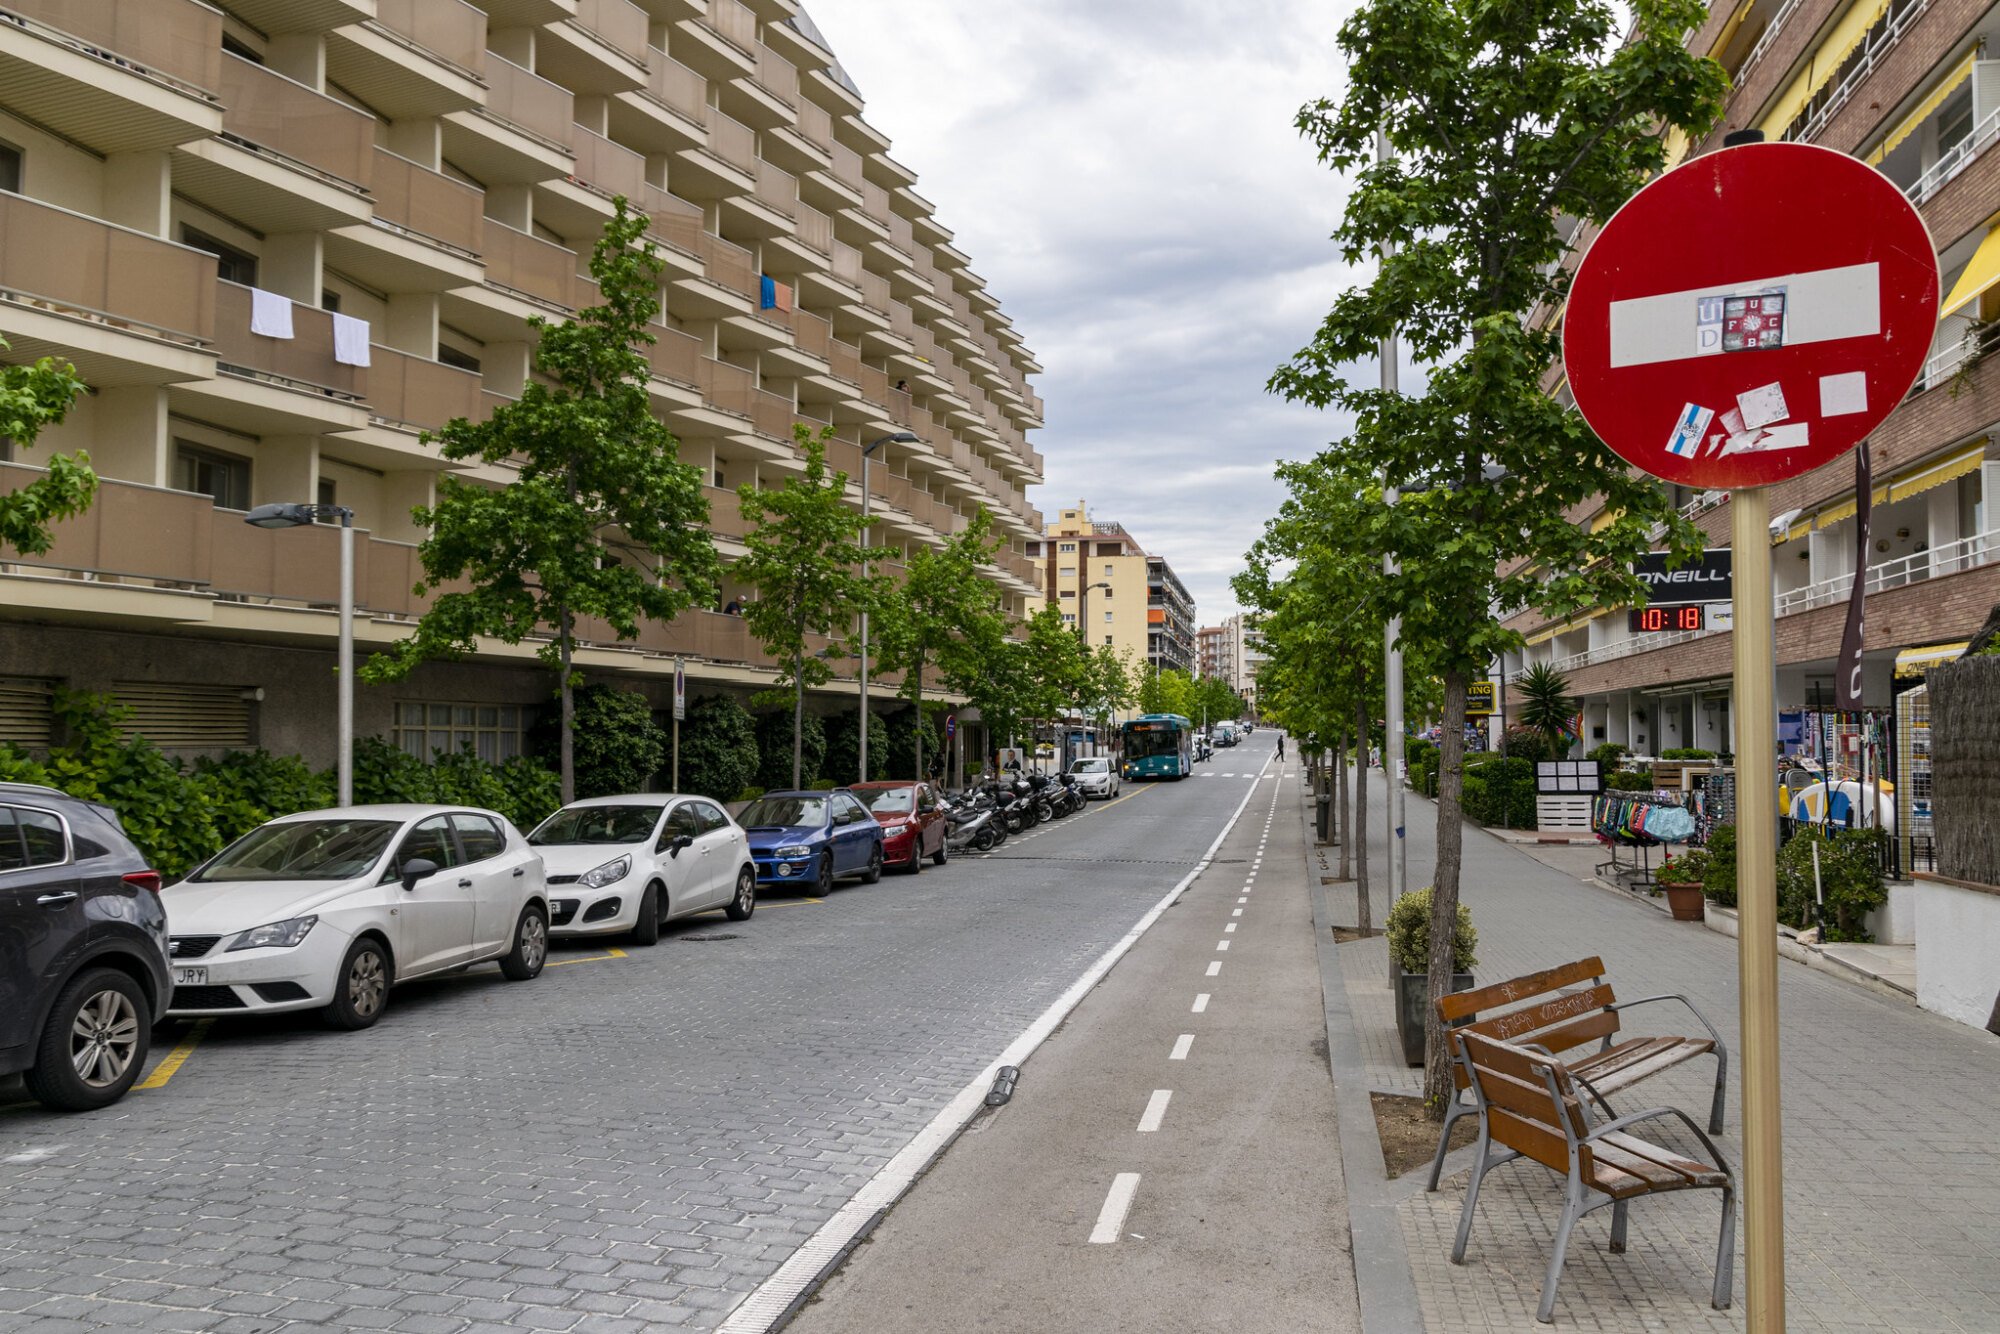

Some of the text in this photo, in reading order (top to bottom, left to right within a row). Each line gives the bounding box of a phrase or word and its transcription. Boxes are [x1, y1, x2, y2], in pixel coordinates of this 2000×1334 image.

[1749, 299, 1758, 309] U
[1728, 317, 1778, 330] F C
